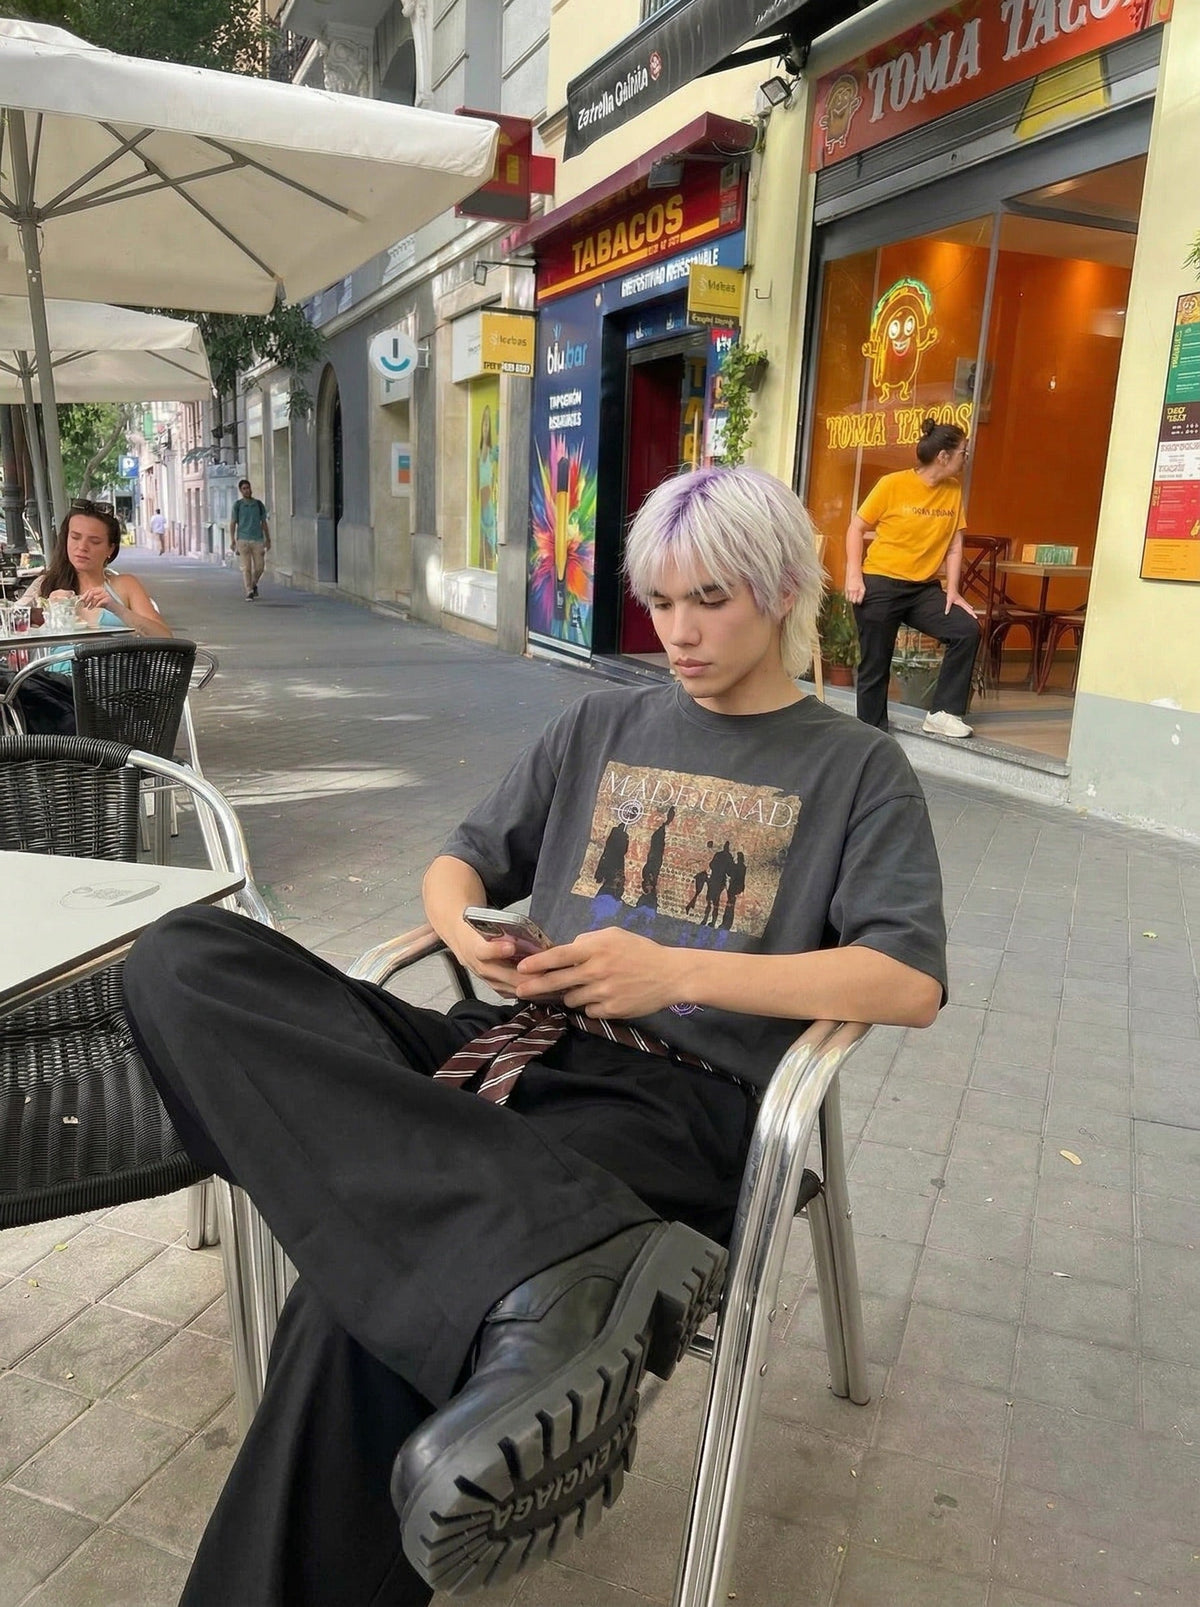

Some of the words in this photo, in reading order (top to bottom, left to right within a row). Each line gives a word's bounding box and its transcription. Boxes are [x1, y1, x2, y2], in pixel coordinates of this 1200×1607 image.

[868, 17, 982, 123] TOMA
[572, 194, 684, 274] TABACOS
[826, 411, 887, 449] TOMA
